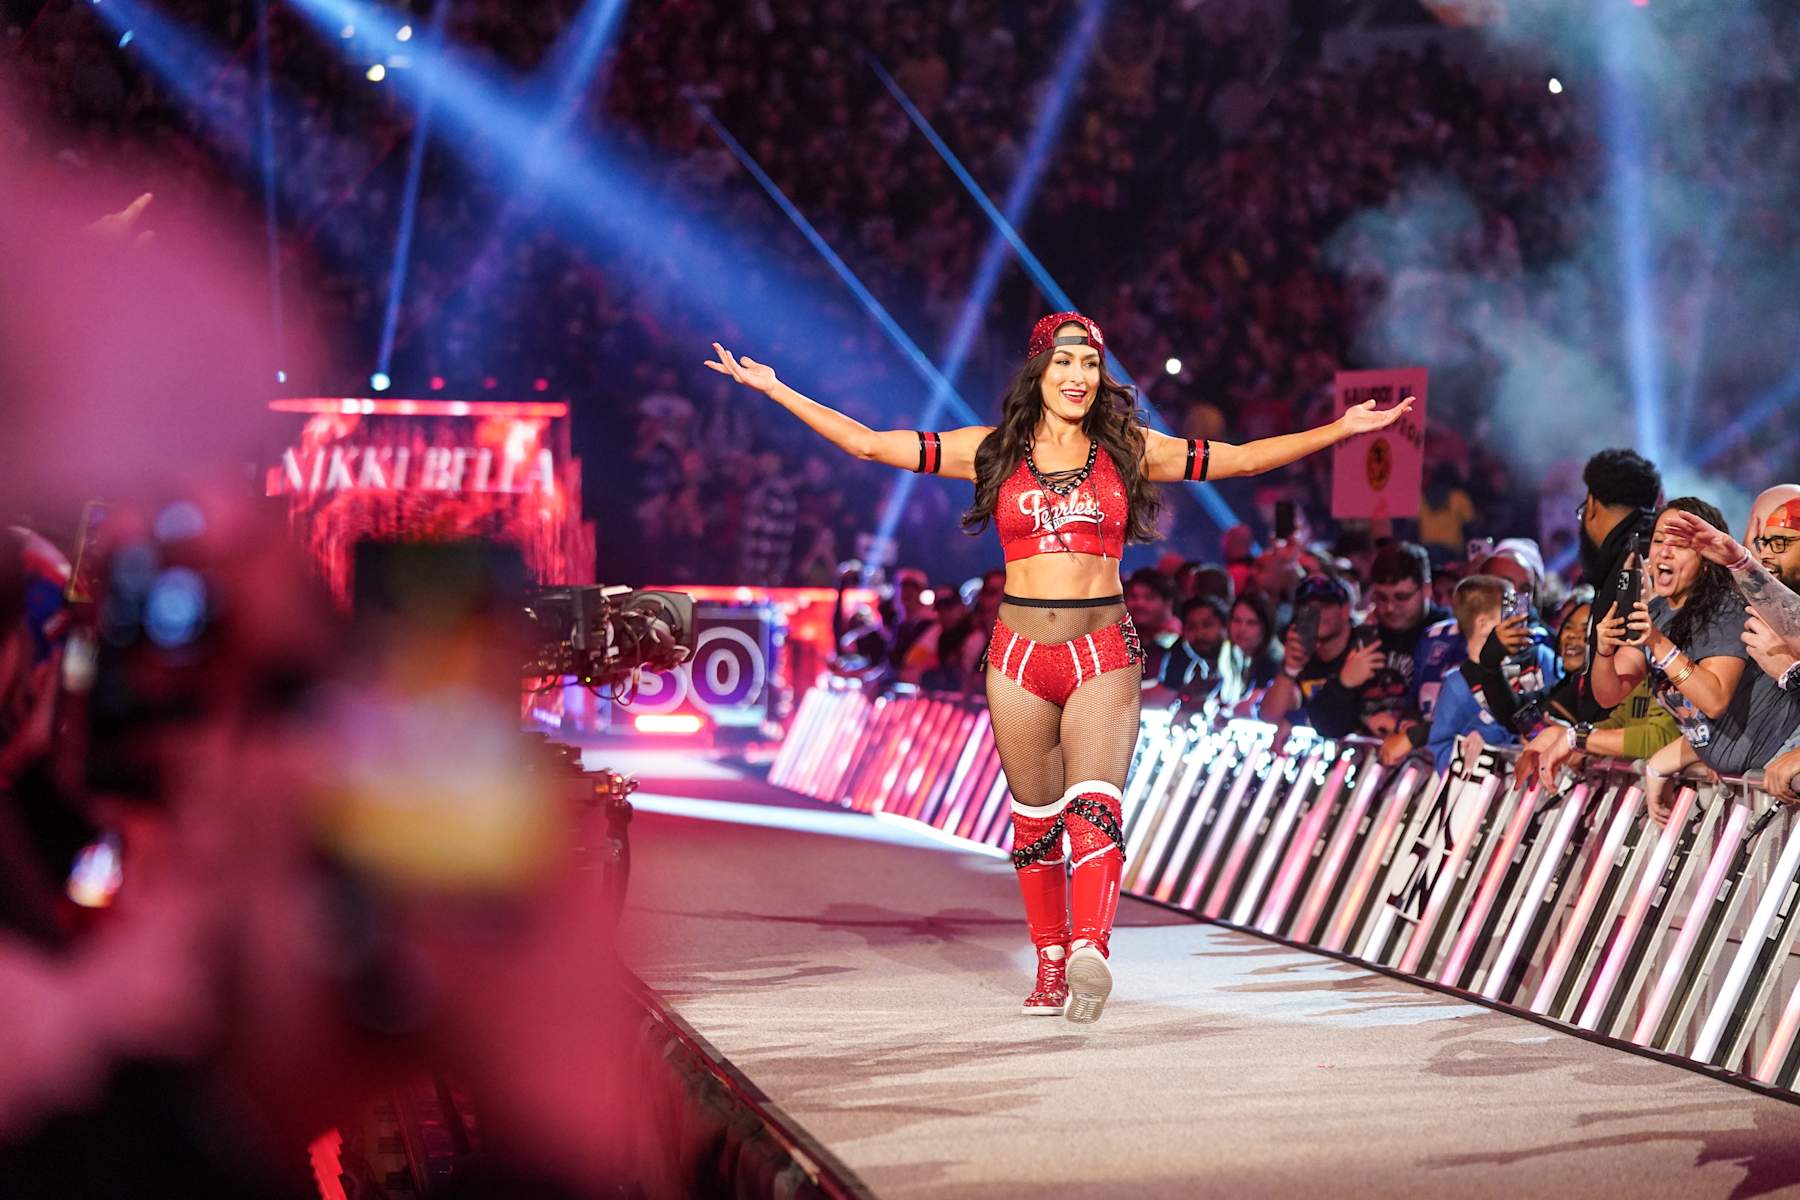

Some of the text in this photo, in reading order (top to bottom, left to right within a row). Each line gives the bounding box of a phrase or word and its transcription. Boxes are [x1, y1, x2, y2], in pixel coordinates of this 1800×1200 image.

[284, 446, 555, 497] NIKKI BELLA
[1018, 488, 1105, 532] Fearless
